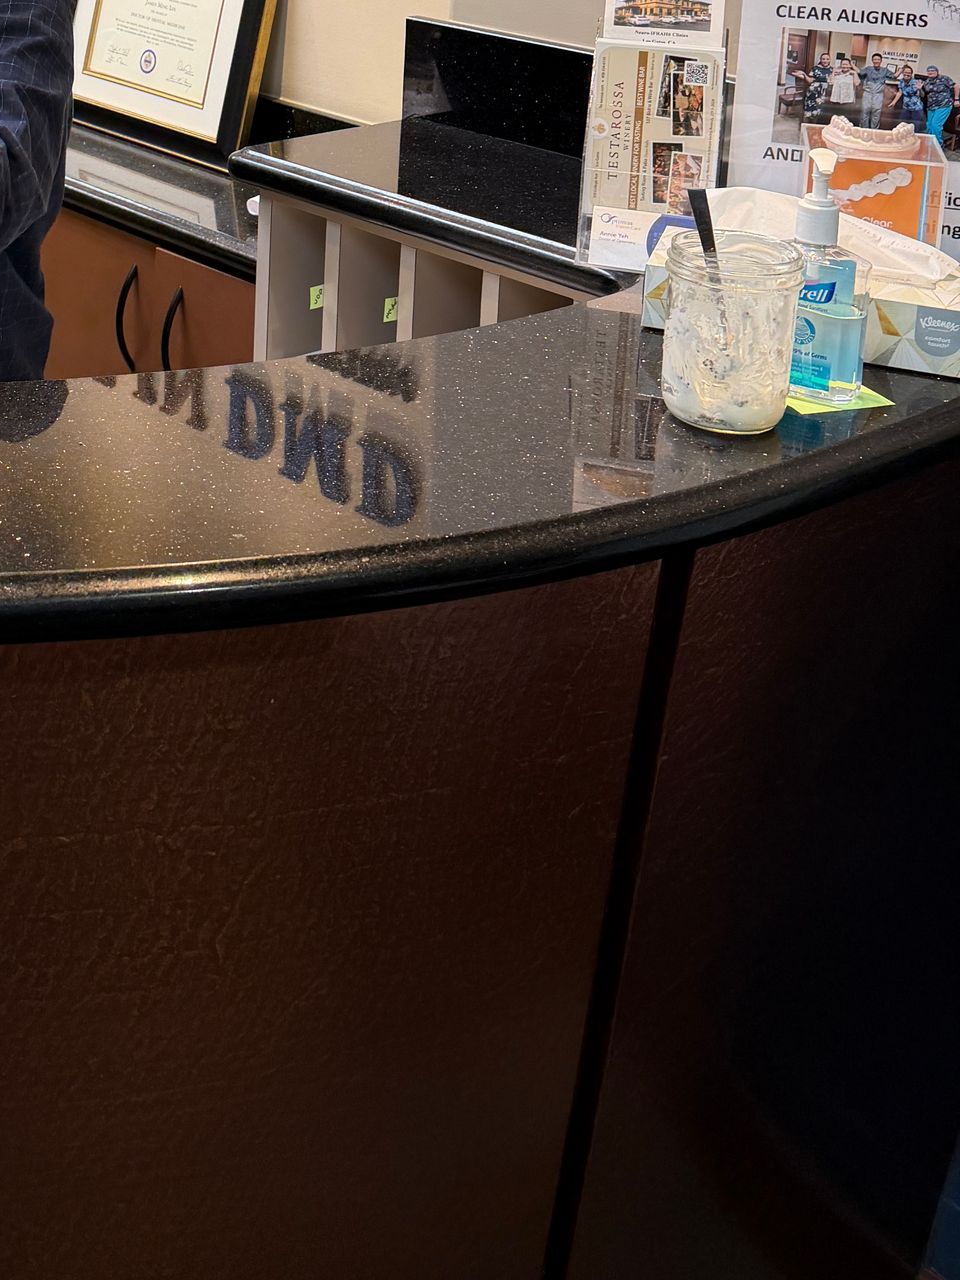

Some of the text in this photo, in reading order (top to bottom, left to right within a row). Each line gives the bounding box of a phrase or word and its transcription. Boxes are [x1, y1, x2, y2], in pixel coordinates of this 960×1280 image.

[776, 4, 928, 28] CLEAR ALIGNERS
[607, 81, 625, 180] TESTAROSSA
[623, 113, 632, 151] WINERY
[634, 120, 642, 143] TASTING
[800, 289, 828, 302] rell
[920, 316, 960, 331] Kleenex
[811, 352, 827, 361] Germs
